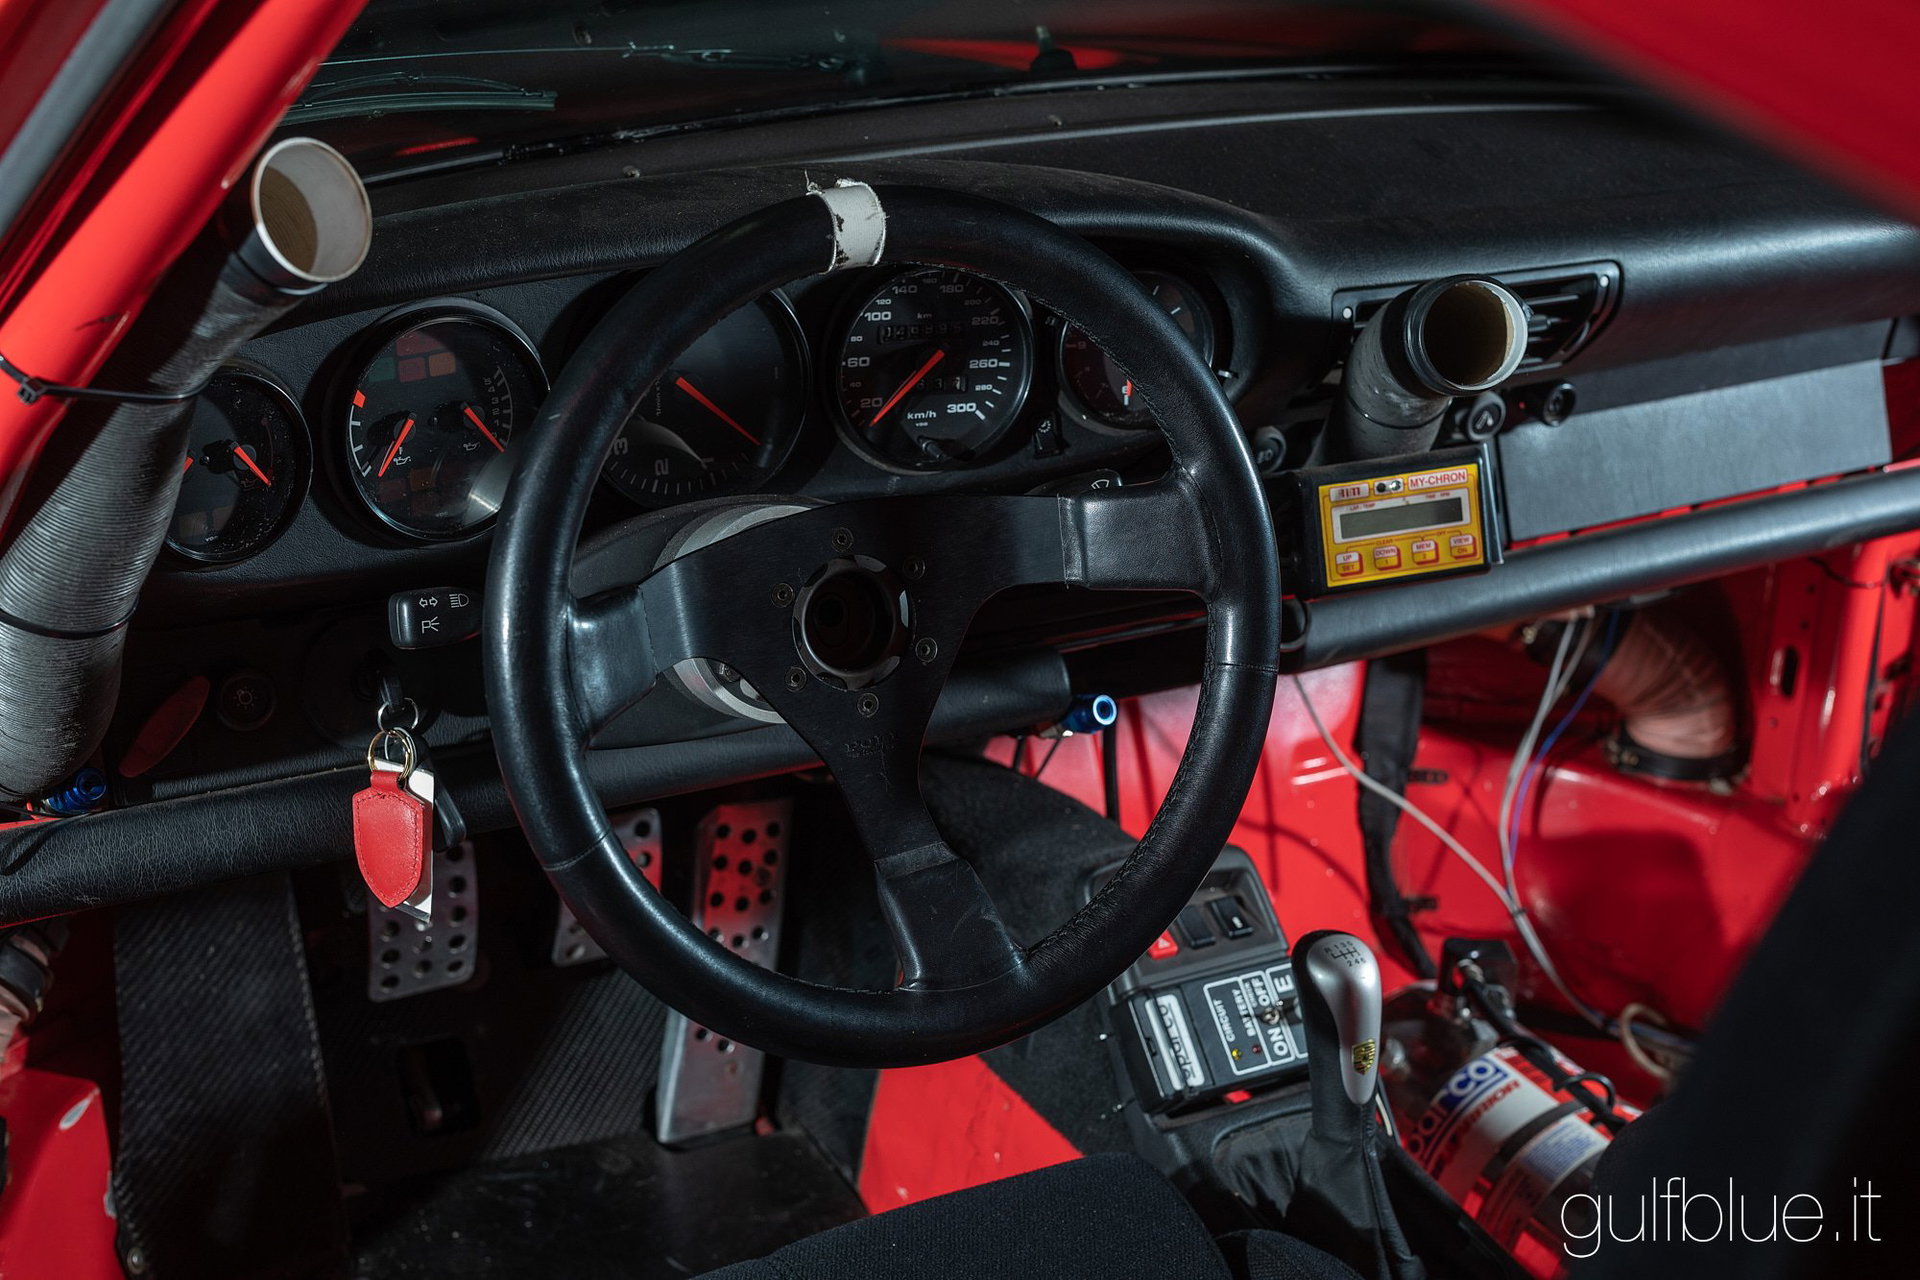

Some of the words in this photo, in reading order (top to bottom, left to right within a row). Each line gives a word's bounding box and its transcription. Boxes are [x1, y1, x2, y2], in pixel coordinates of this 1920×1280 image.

[891, 285, 918, 294] 140
[939, 285, 964, 293] 180
[864, 311, 892, 321] 100
[917, 312, 932, 320] km
[971, 317, 999, 326] 220
[847, 356, 870, 368] 60
[969, 358, 998, 369] 260
[860, 397, 883, 408] 20
[947, 403, 977, 414] 300
[907, 410, 937, 420] km/h
[613, 436, 629, 456] 3
[655, 457, 670, 476] 2
[1410, 471, 1466, 489] MY-CHRON
[1452, 537, 1470, 545] VIEW
[1375, 548, 1396, 557] DOWN
[1274, 974, 1295, 993] E
[1252, 977, 1271, 1007] OFF
[1232, 988, 1257, 1037] BATTERY
[1213, 998, 1236, 1043] CIRCUIT
[1267, 1028, 1289, 1057] ON
